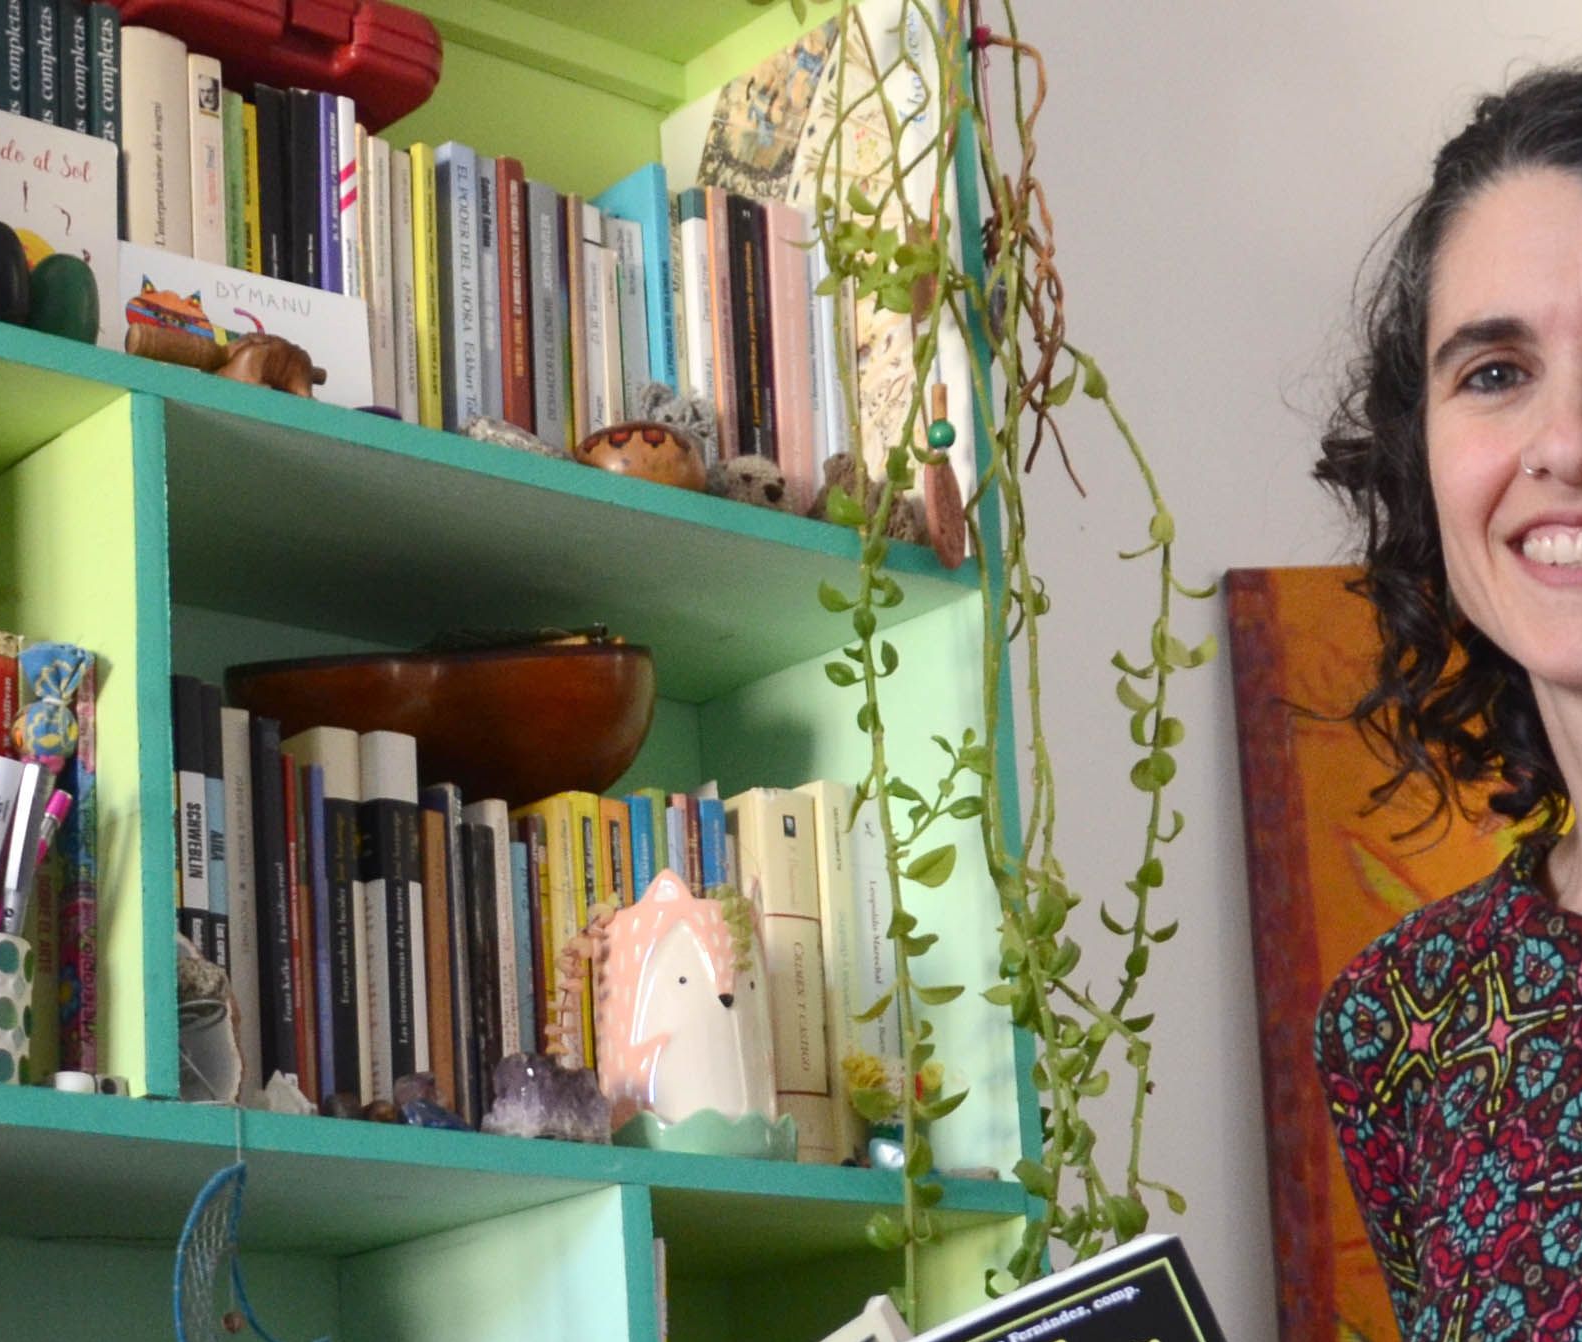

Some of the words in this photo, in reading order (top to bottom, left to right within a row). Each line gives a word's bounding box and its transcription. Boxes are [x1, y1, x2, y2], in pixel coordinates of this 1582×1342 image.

[38, 5, 58, 102] completas
[71, 15, 91, 111] completas
[98, 17, 119, 113] completas
[32, 149, 51, 173] al
[60, 153, 92, 184] Sol
[457, 164, 469, 183] EL
[457, 186, 471, 239] PODER
[459, 242, 472, 271] DEL
[248, 286, 312, 317] MANU
[461, 278, 475, 331] AHORA
[463, 341, 477, 392] Eckhart
[185, 801, 204, 879] SCHWEBLIN
[210, 829, 225, 861] AIRA
[395, 887, 405, 922] muerte
[280, 957, 291, 990] Kafka
[398, 1025, 409, 1044] Las
[1092, 1285, 1141, 1310] comp.
